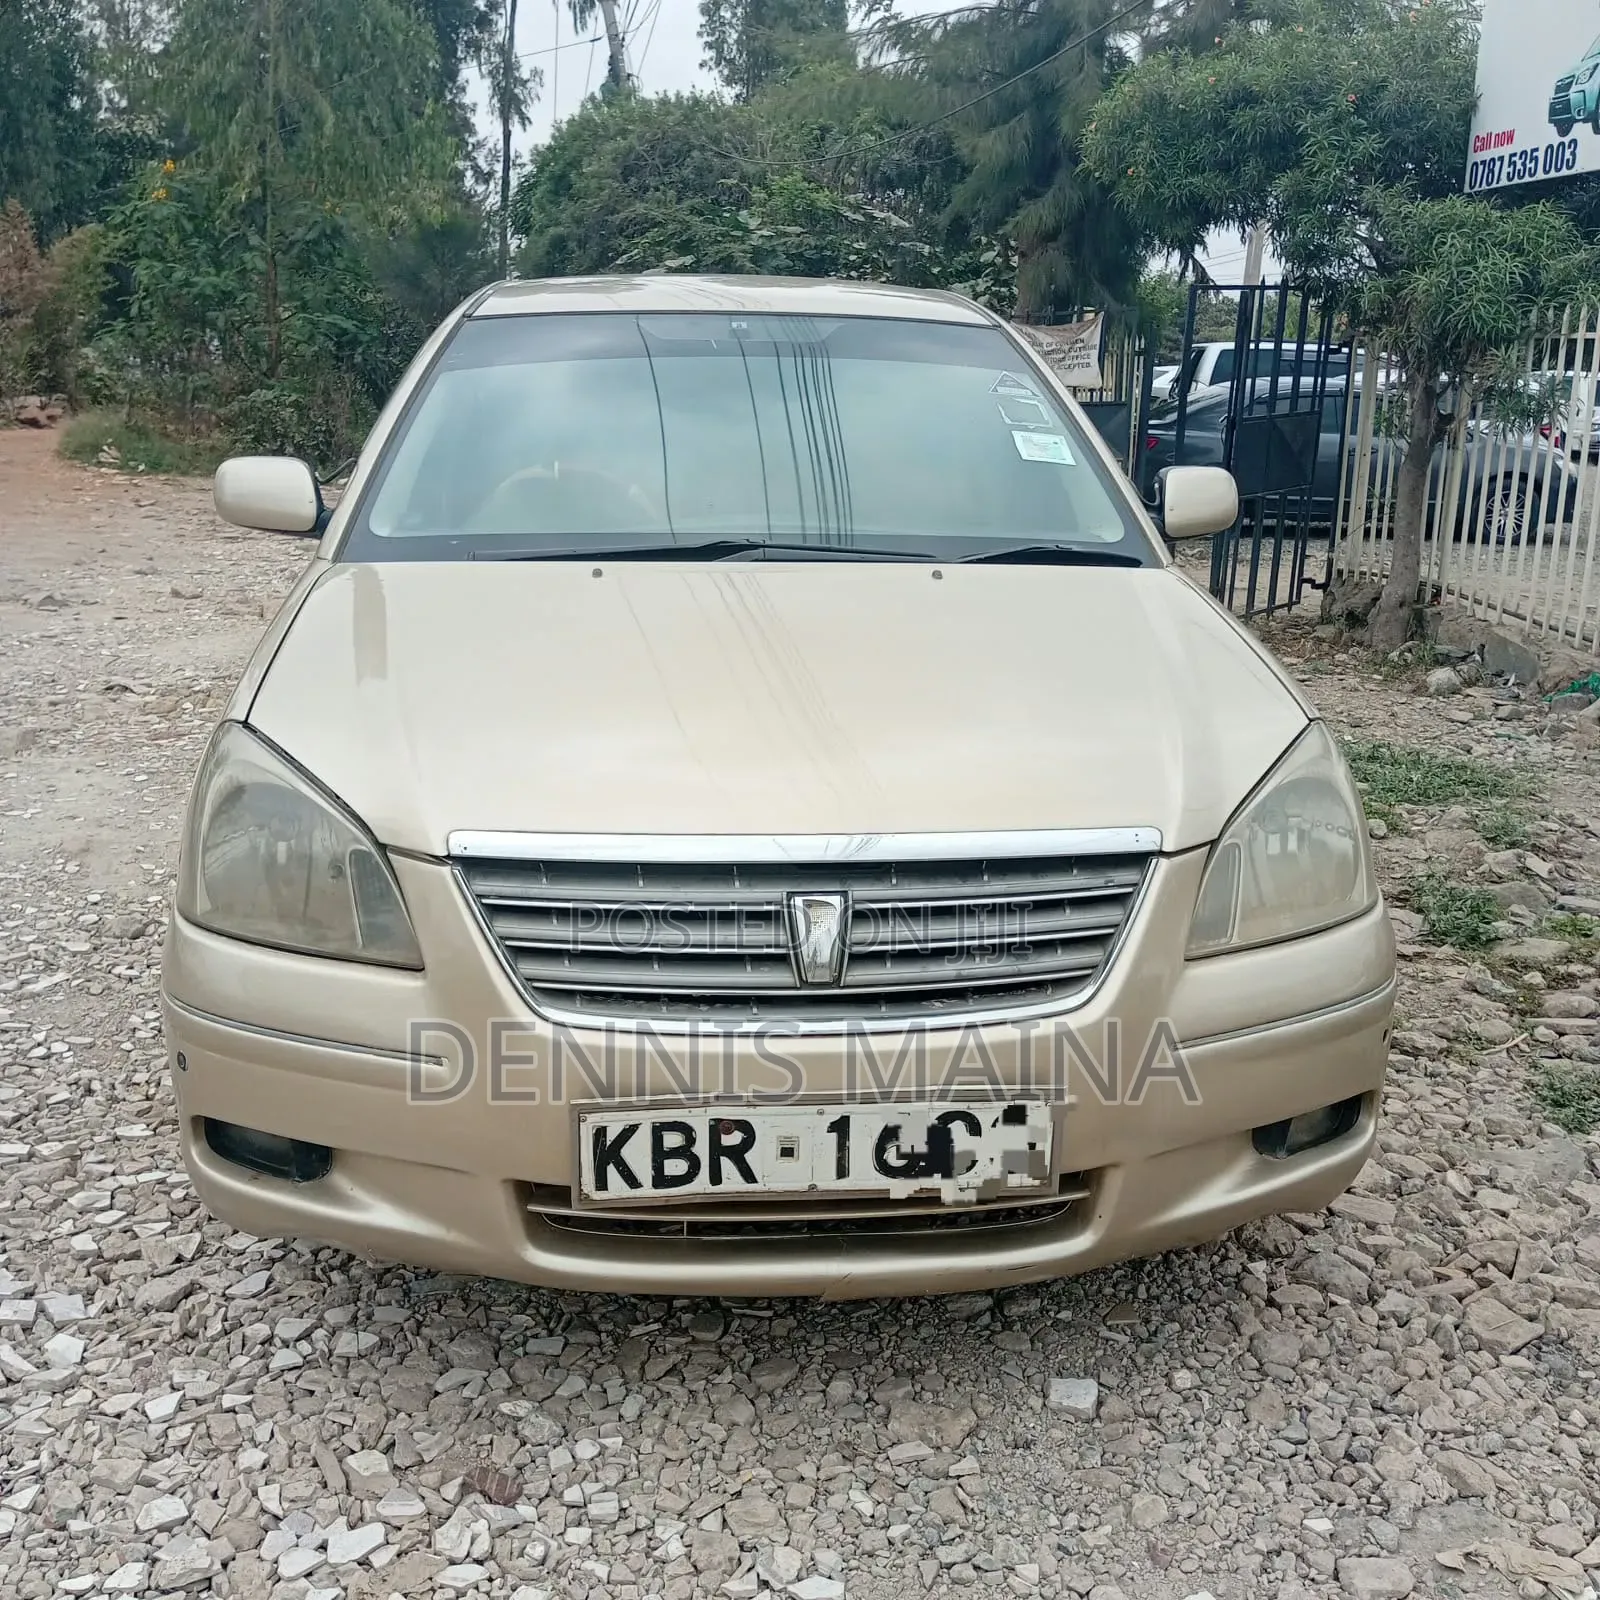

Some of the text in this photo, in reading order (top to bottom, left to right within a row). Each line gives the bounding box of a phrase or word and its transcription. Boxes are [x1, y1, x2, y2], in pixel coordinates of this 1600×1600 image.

[1469, 138, 1578, 190] 0787 535 003
[1473, 129, 1515, 153] Call now
[592, 1118, 759, 1191] KBR
